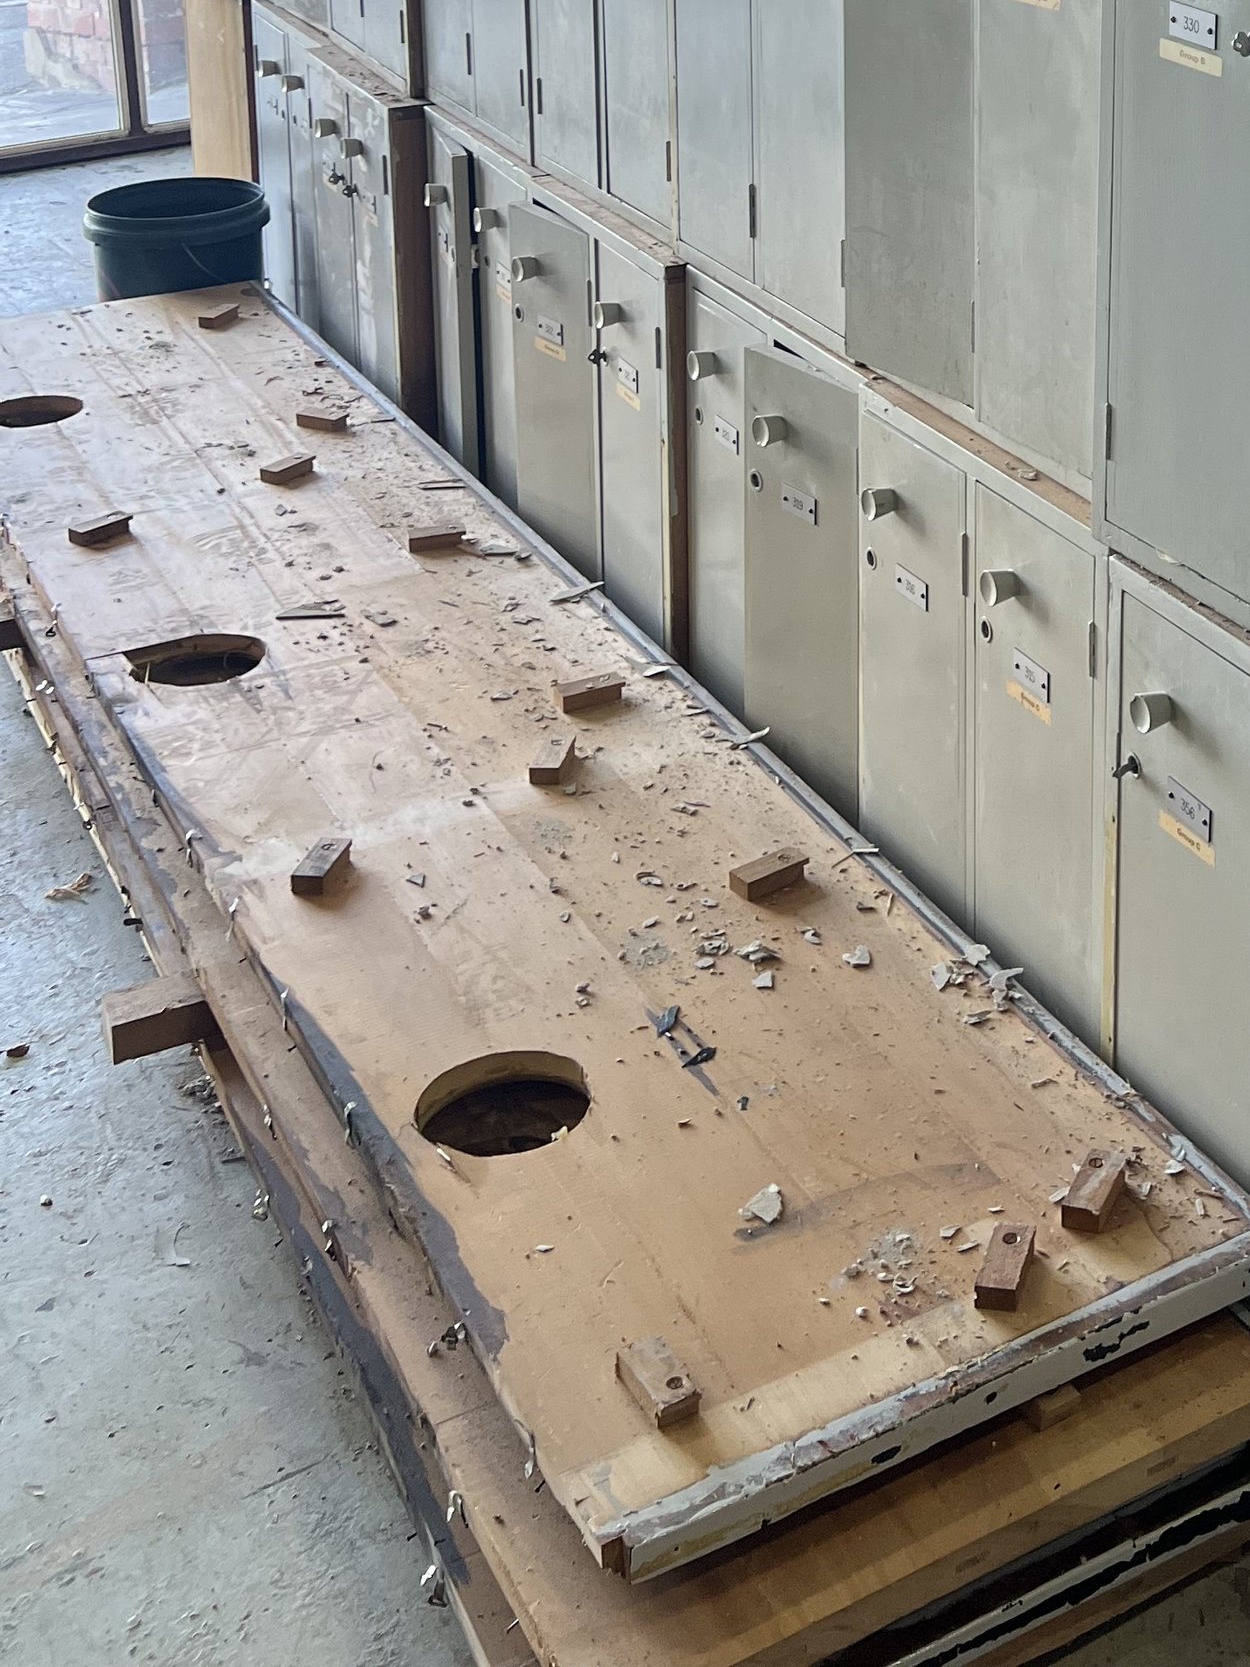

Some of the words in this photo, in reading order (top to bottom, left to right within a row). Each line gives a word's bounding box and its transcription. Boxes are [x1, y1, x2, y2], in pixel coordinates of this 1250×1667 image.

[1184, 16, 1199, 33] 330
[1179, 50, 1198, 64] Group
[1181, 798, 1194, 820] 356
[1176, 828, 1196, 847] Group
